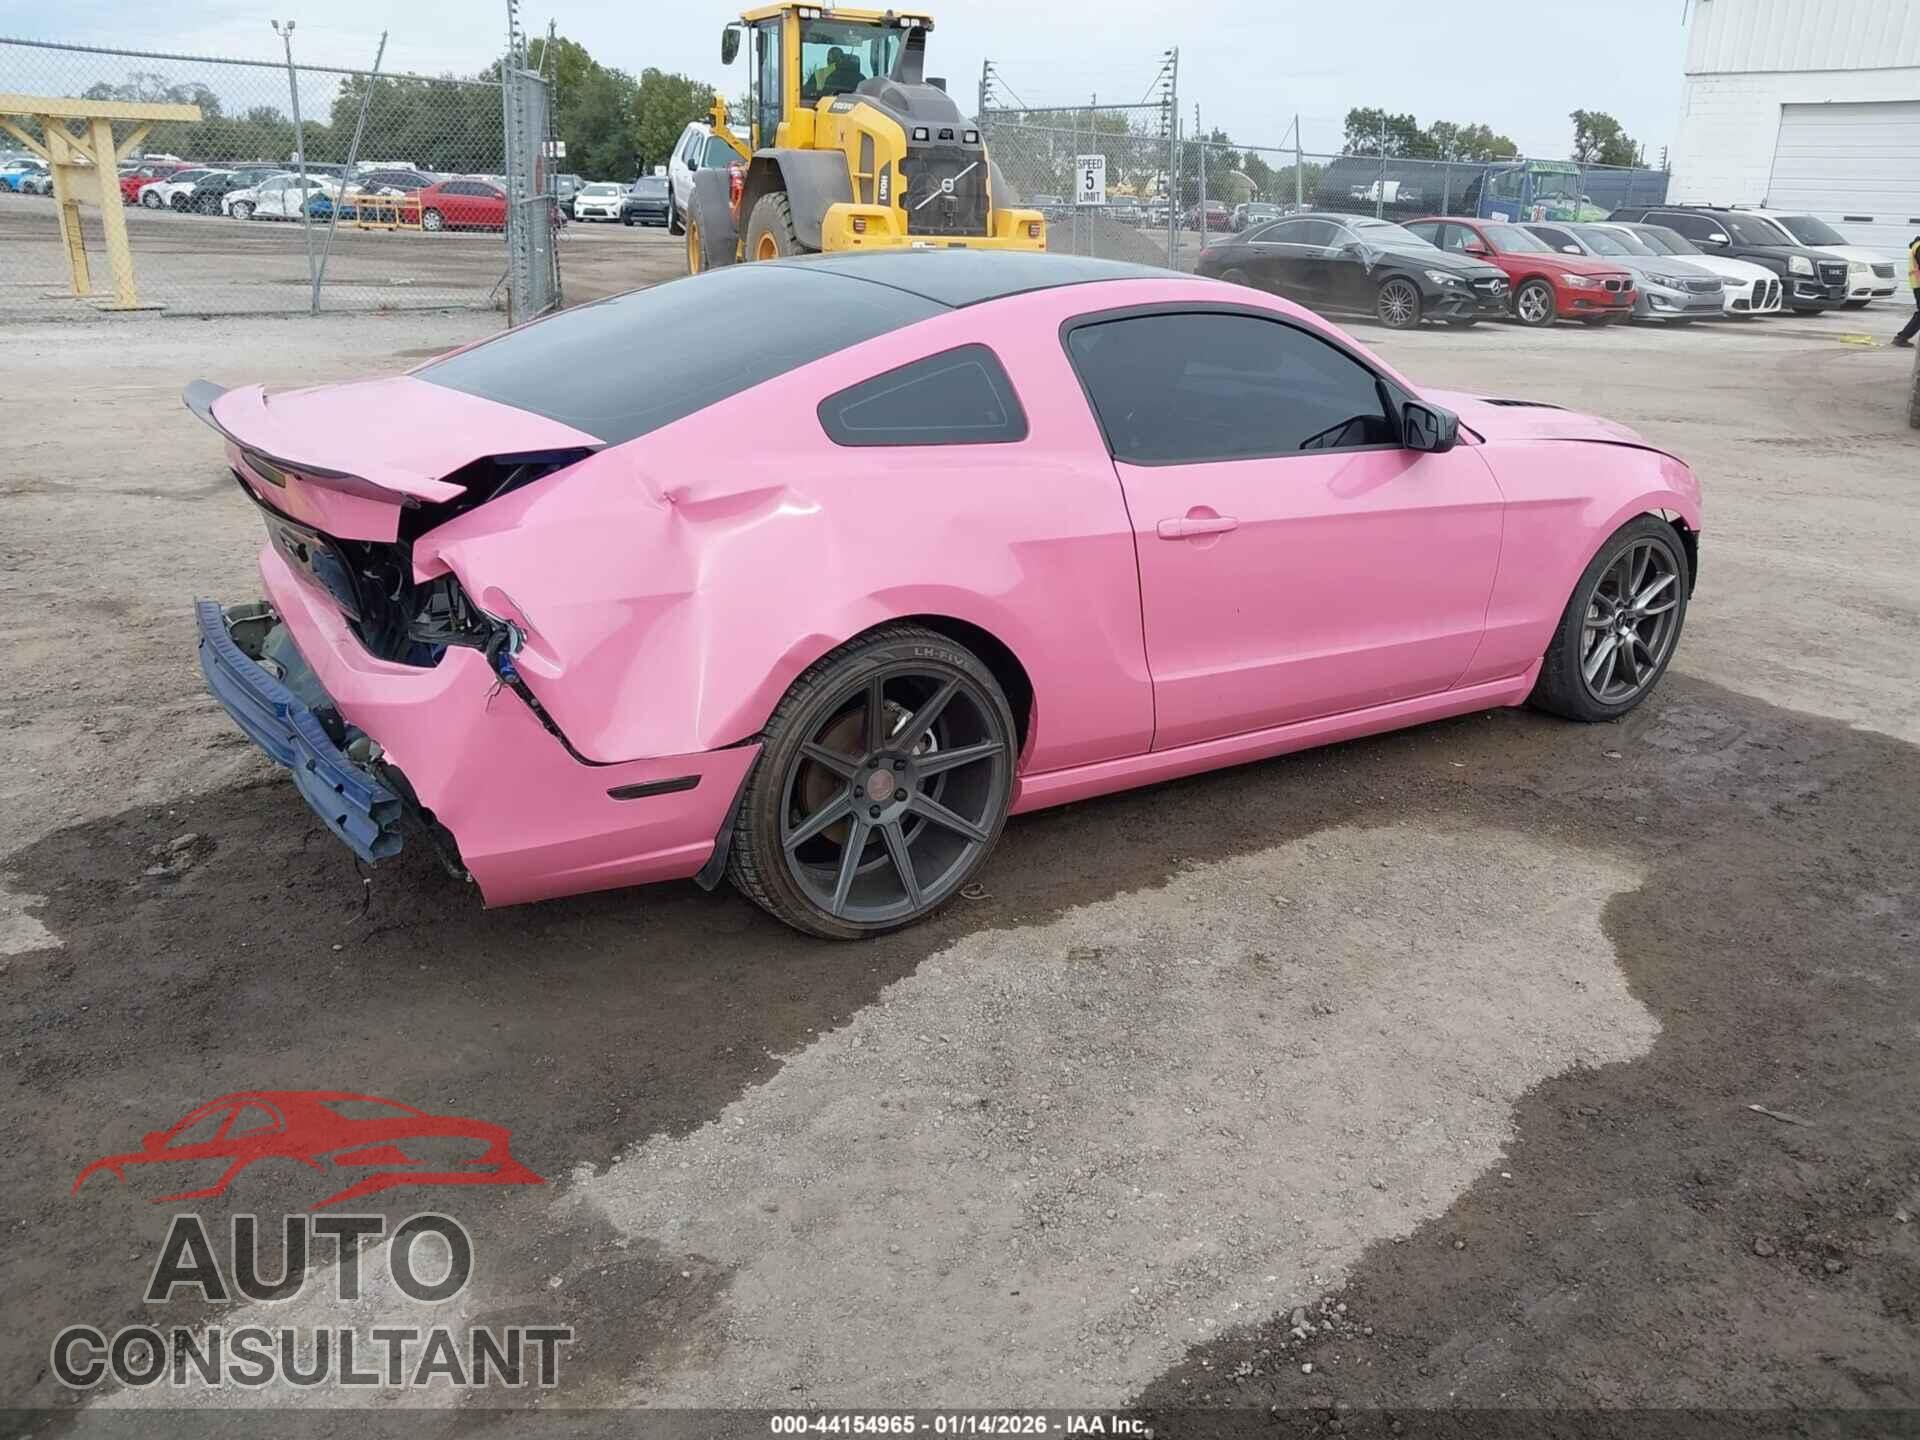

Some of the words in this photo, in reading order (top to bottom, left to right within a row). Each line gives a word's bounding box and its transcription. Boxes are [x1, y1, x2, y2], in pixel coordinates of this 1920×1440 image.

[1077, 158, 1103, 170] SPEED
[1085, 170, 1095, 190] 5
[1079, 191, 1101, 203] LIMIT
